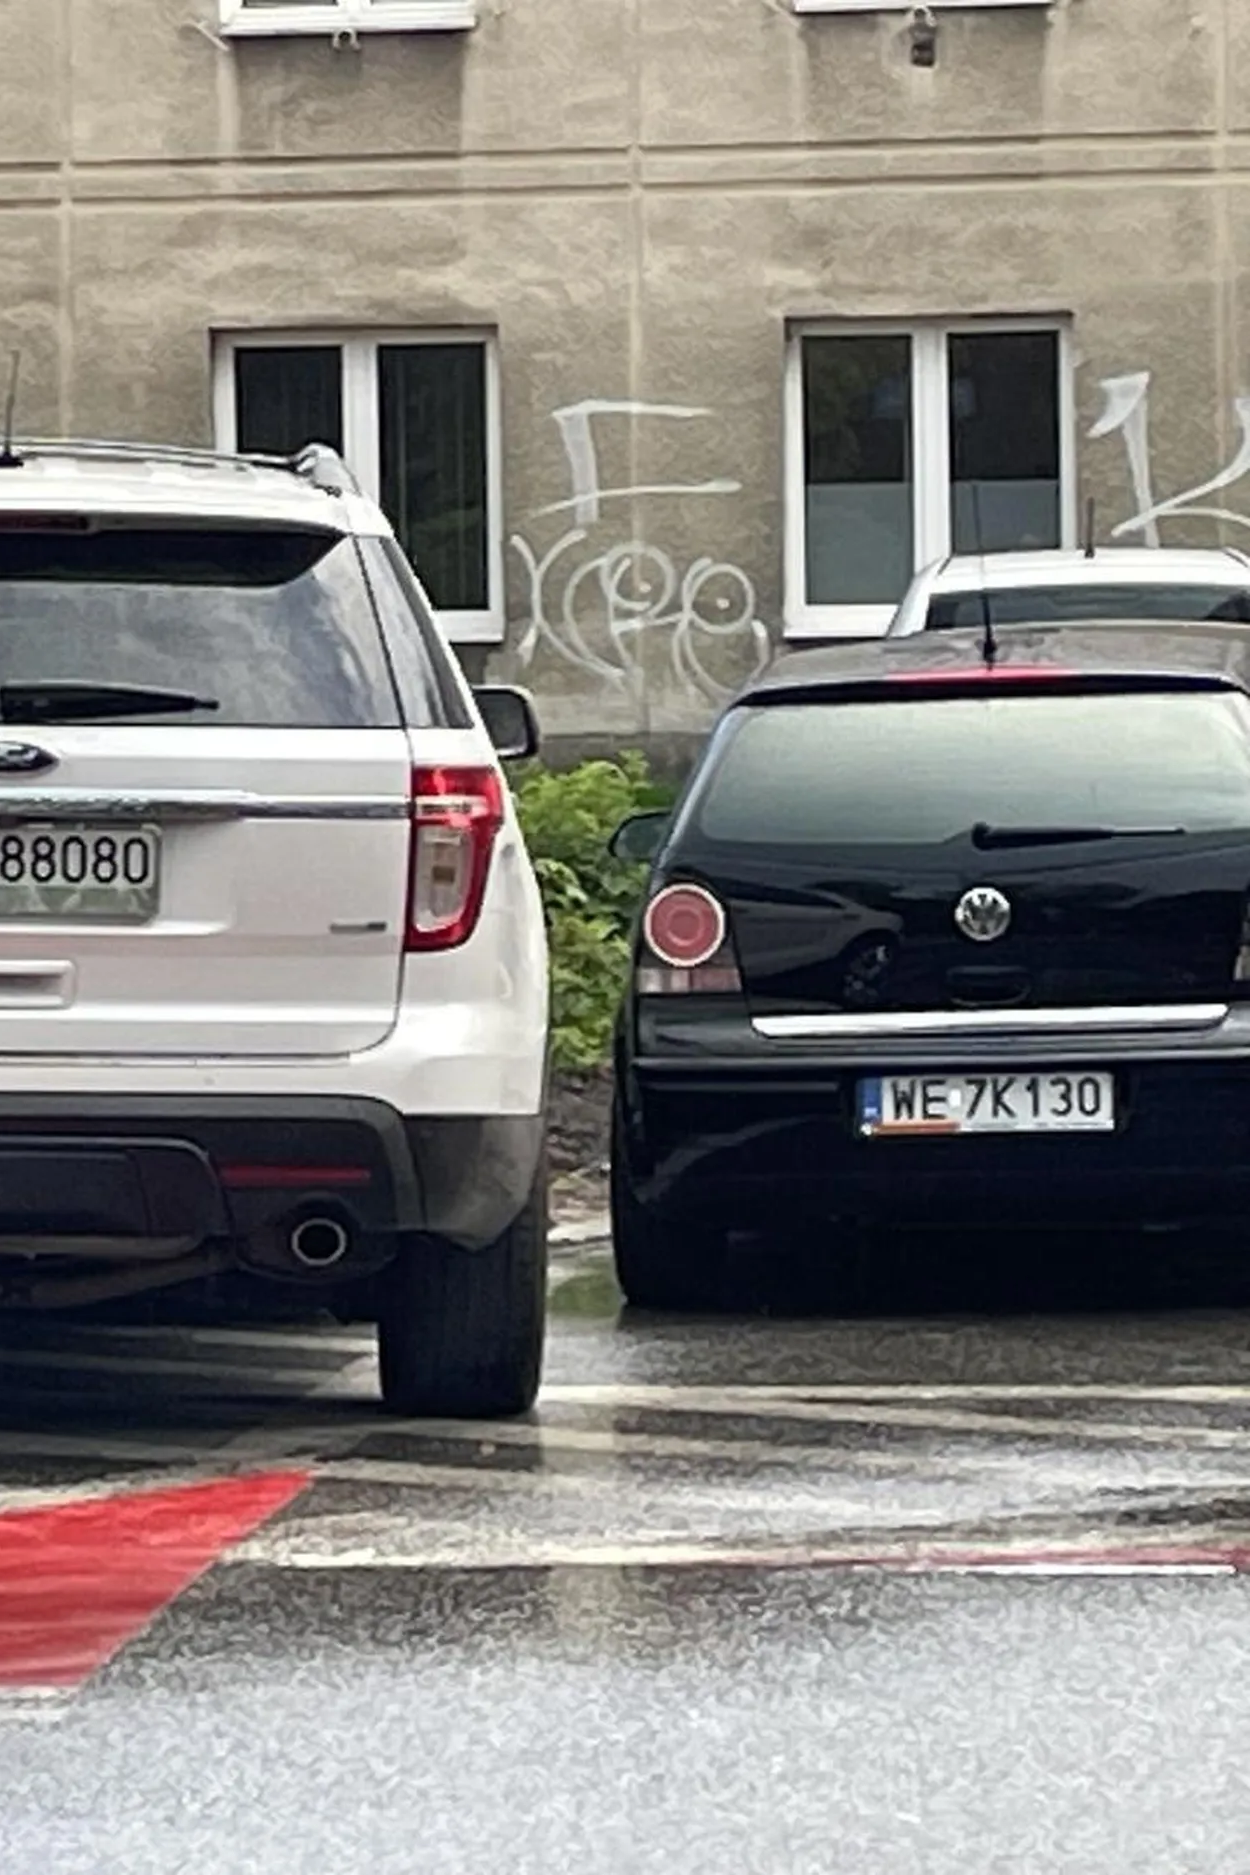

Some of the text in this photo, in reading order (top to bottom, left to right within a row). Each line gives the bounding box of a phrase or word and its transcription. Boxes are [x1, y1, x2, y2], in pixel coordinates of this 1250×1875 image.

[0, 835, 149, 884] 88080
[890, 1077, 1100, 1119] WE 7K130
